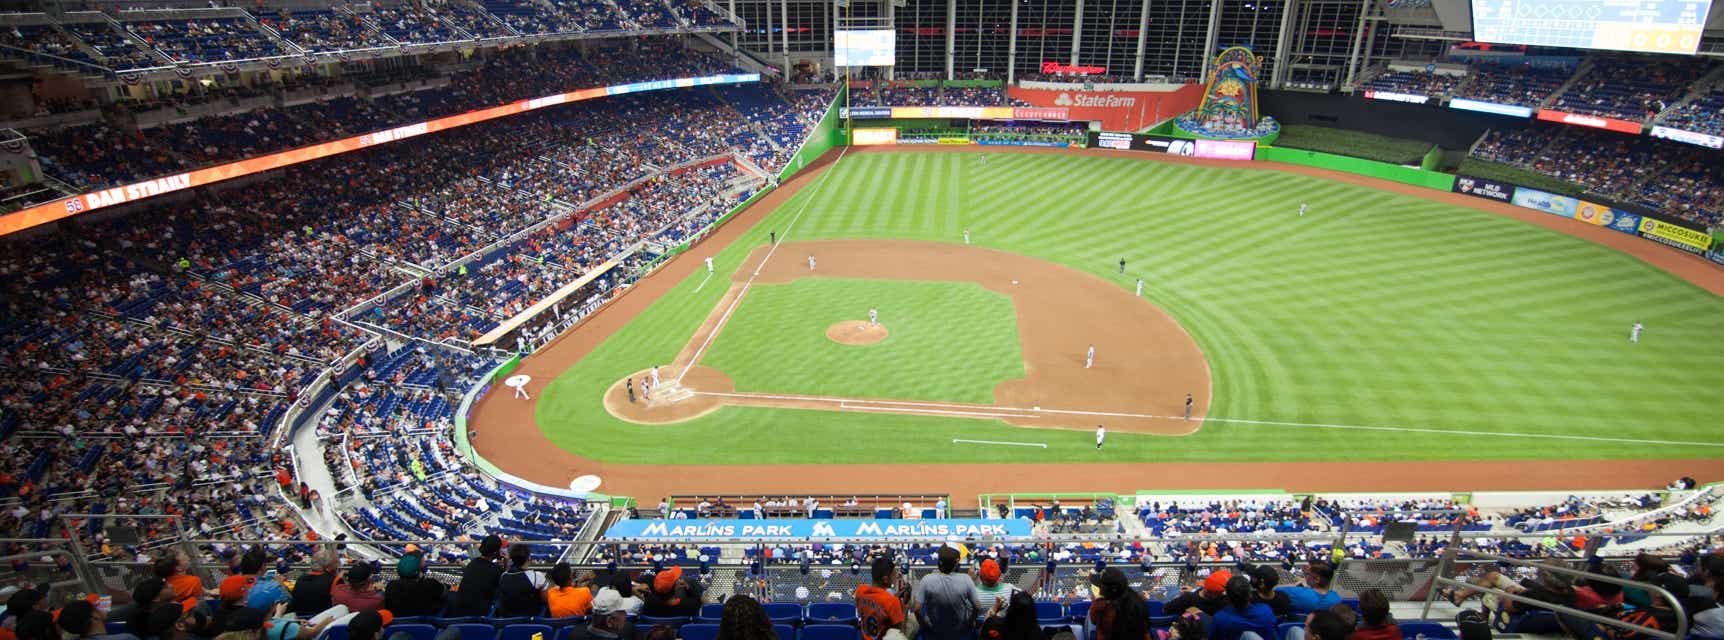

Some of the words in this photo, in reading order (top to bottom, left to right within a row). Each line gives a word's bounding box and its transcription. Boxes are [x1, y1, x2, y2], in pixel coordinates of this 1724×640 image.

[86, 187, 126, 209] DAN
[126, 173, 191, 201] STRAILY
[1473, 187, 1508, 200] NETWORK
[1485, 183, 1501, 192] MLB
[1656, 223, 1709, 243] MICCOSUKEE
[642, 522, 735, 537] MARLINS
[742, 525, 792, 536] PARK
[856, 521, 948, 536] MARLINS
[956, 524, 1007, 536] PARK
